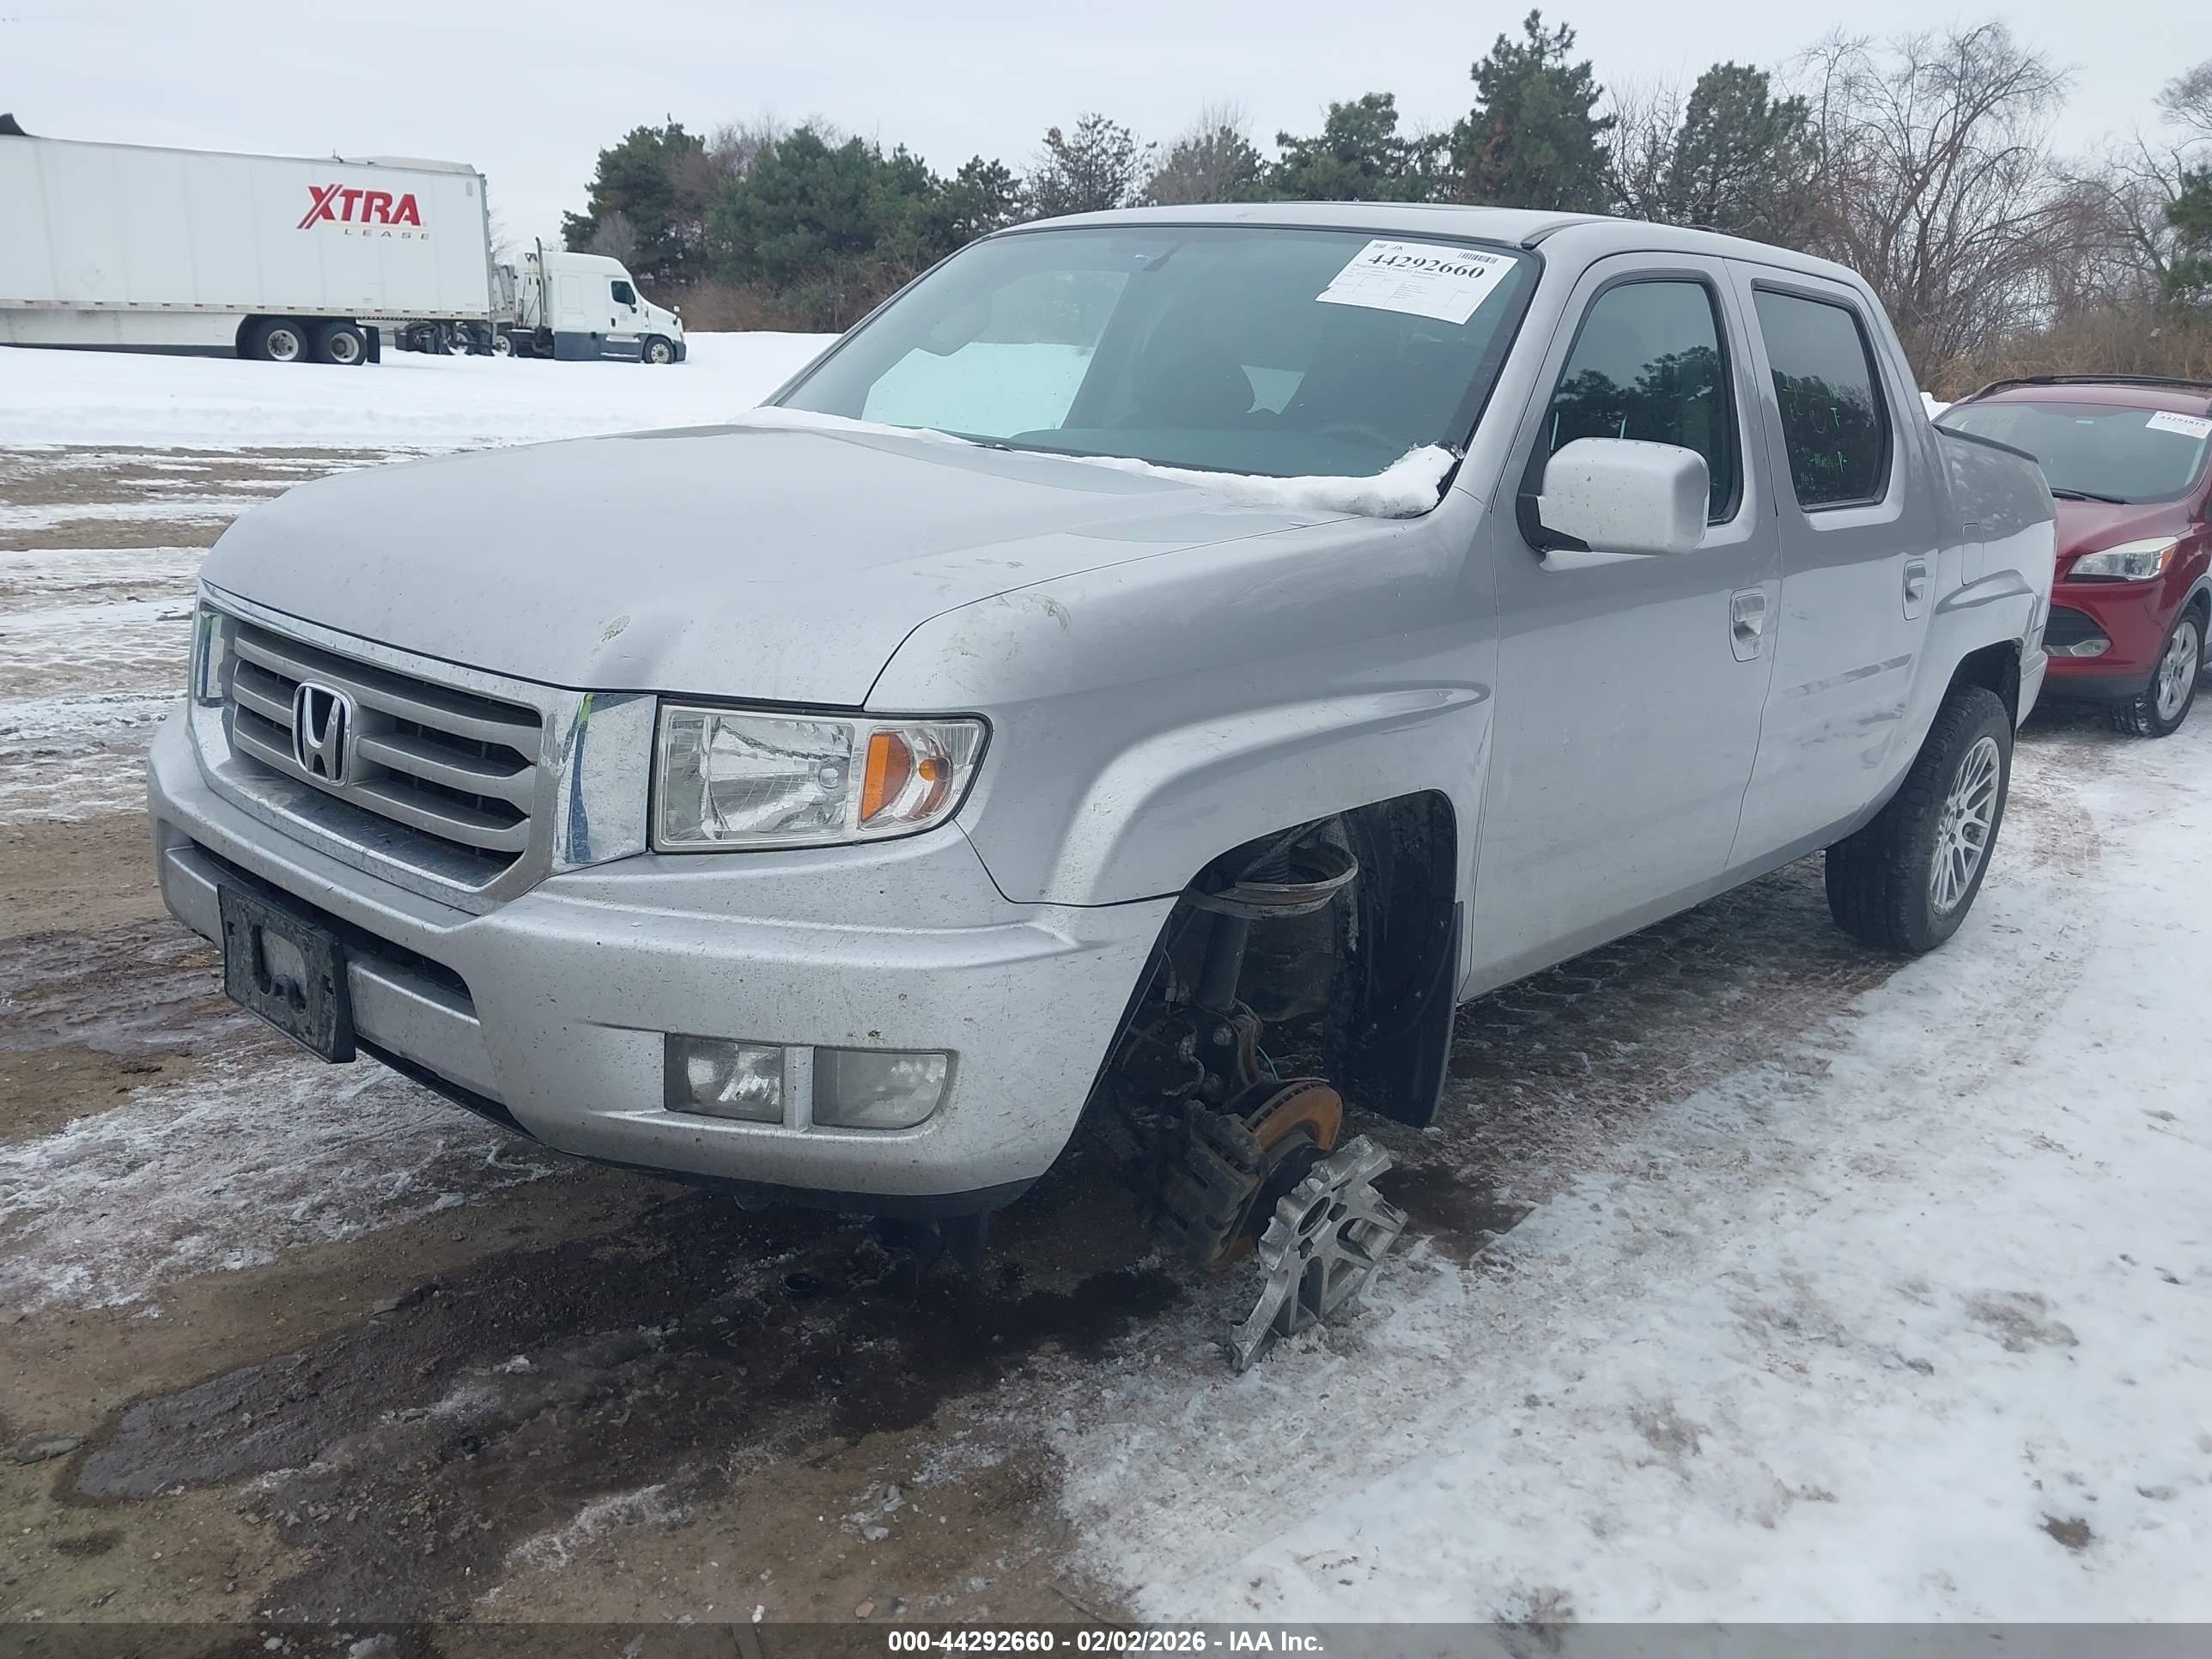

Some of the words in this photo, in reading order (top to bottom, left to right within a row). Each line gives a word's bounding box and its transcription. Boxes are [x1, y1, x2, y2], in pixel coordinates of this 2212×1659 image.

[296, 184, 421, 229] XTRA
[344, 228, 430, 240] LEASE
[1368, 253, 1486, 279] 44292660
